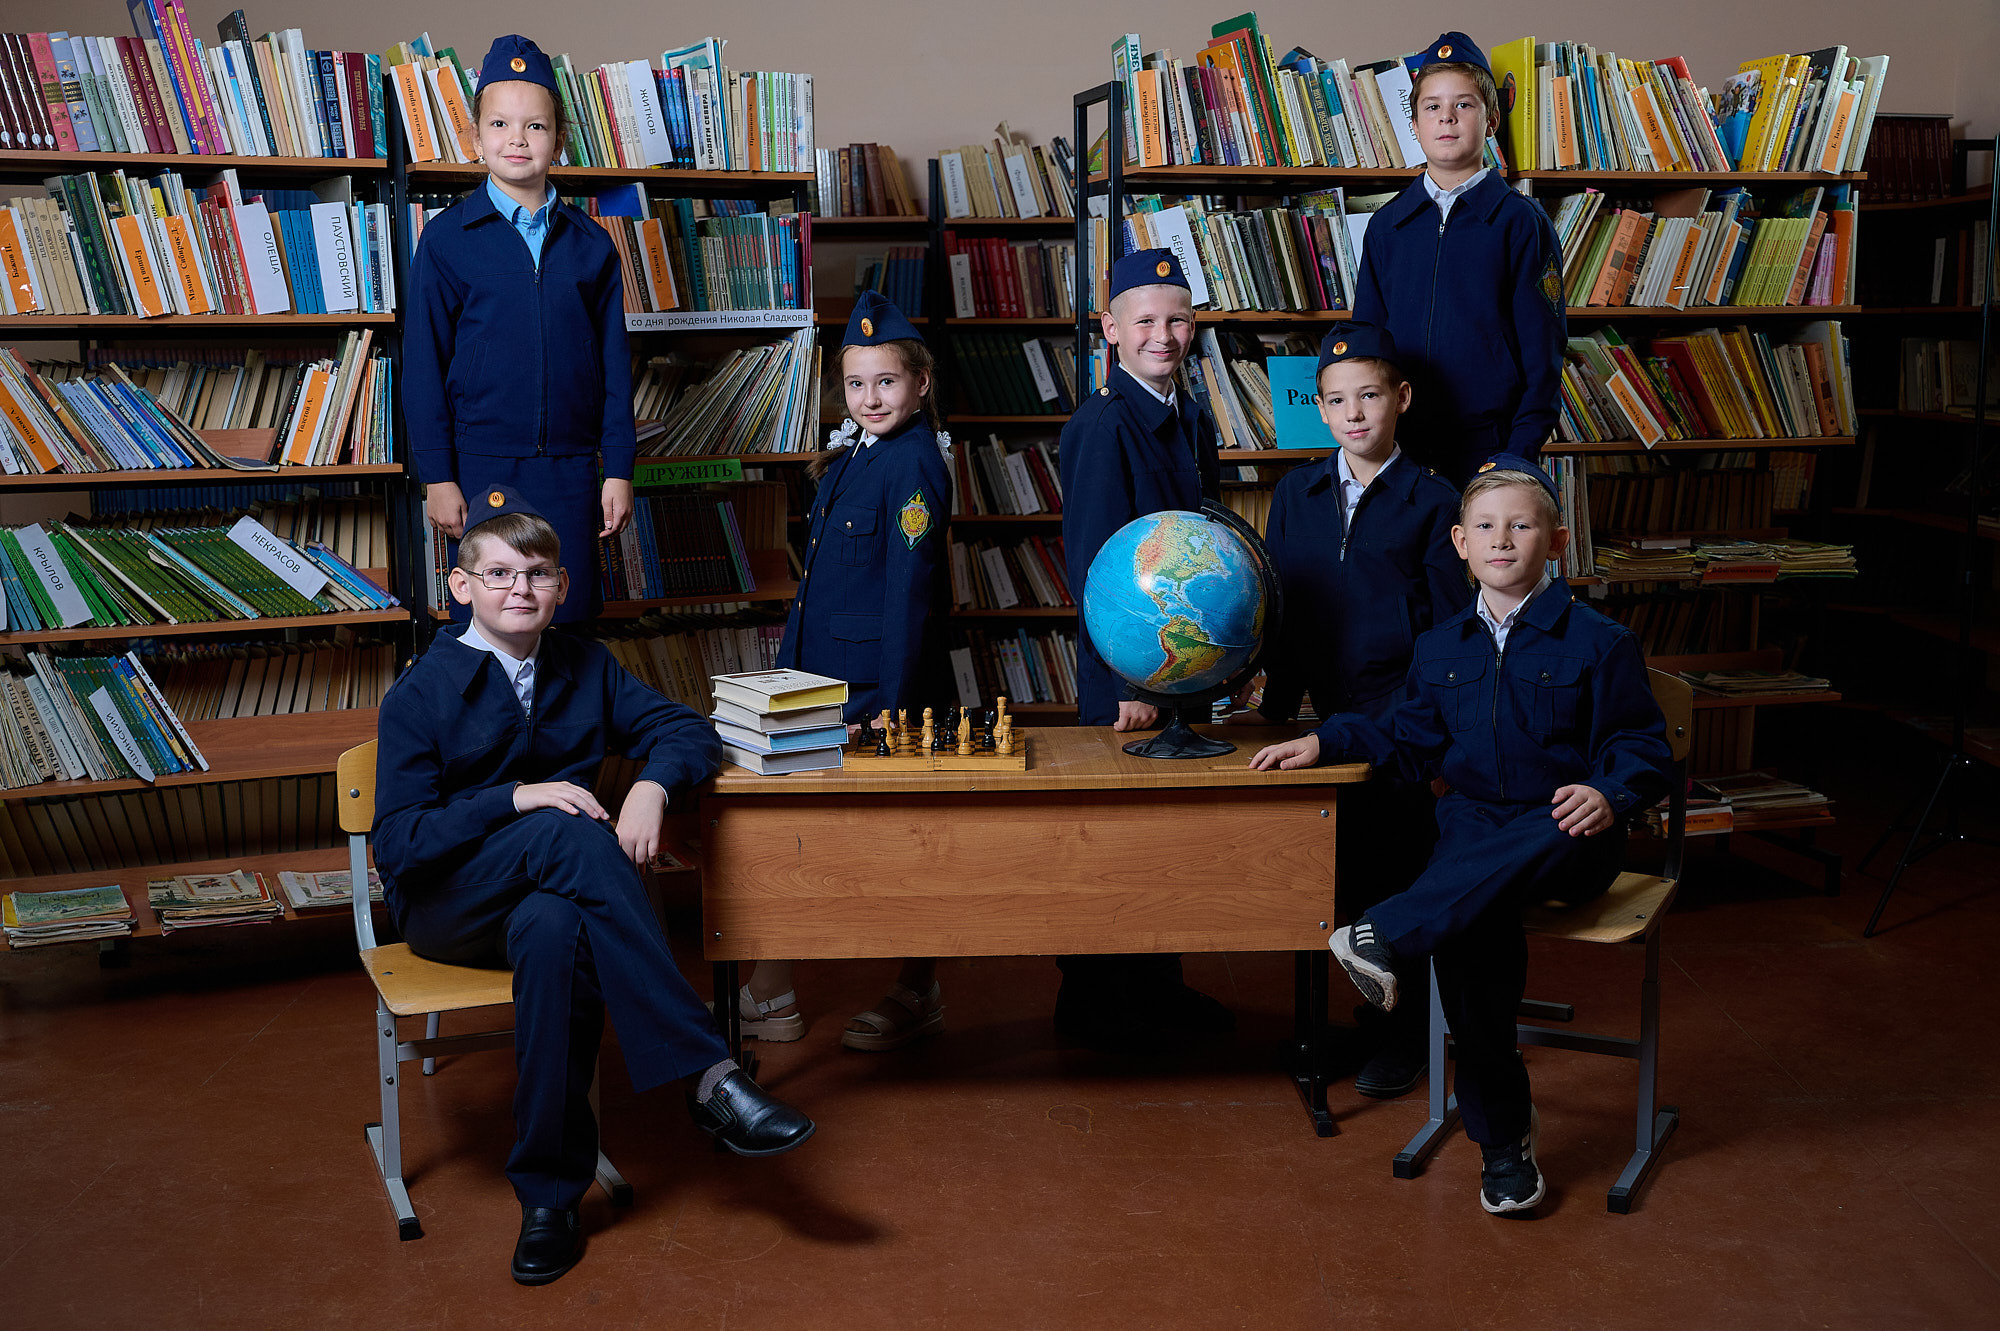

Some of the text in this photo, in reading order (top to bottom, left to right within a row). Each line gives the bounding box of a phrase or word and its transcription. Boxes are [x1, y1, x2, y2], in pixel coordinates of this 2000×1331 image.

[182, 21, 196, 58] РОССИИ
[107, 62, 116, 82] РОССИИ
[116, 63, 125, 82] РОССИИ
[160, 15, 199, 132] СКАЗКИ НАРОДОВ РОССИИ
[1129, 43, 1140, 72] АЗКИ
[131, 82, 139, 91] ЗА
[146, 82, 154, 92] ЗА
[163, 90, 171, 99] ЗА
[193, 60, 209, 102] НАРОДОВ
[404, 76, 416, 106] природе
[142, 117, 149, 126] ЗА
[156, 117, 164, 126] ЗА
[205, 104, 219, 138] СКАЗКИ
[447, 97, 463, 134] Бианки В.
[640, 88, 656, 135] ЖИТКОВ
[700, 93, 716, 164] БРОДЯГИ СЕВЕРА
[1140, 90, 1152, 159] Сказки зарубежных
[1149, 99, 1159, 134] писателей
[1312, 87, 1335, 155] СКАЗКИ СТАРОЙ АНГЛИИ
[1645, 110, 1657, 132] Барто
[1833, 113, 1846, 139] Заходер
[173, 126, 181, 134] ЗА
[412, 113, 424, 147] Рассказы
[1559, 115, 1567, 148] Сборники
[946, 158, 961, 203] Математика
[1013, 169, 1024, 196] Физика
[3, 242, 12, 252] П.
[173, 235, 188, 270] Сибиряк
[264, 231, 280, 276] ОЛЕША
[329, 215, 354, 299] ПАУСТОВСКИЙ
[378, 235, 386, 262] СКАЗКИ
[650, 244, 662, 283] Сладков Н.
[1170, 233, 1191, 278] БЁРНЕТТ
[1675, 239, 1694, 283] Маяковский
[134, 249, 151, 285] Ершов П.
[184, 273, 196, 300] Мамин
[631, 312, 808, 328] со дня рождения Николая Сладкова
[1000, 302, 1007, 312] 2
[1010, 302, 1017, 312] 3
[99, 381, 135, 424] АЛЕКСАНДР ПУШКИН
[297, 405, 310, 433] Толстой
[1615, 390, 1647, 430] К. Чуковский
[7, 405, 37, 445] Пушкин А.
[643, 462, 733, 484] ДРУЖИТЬ
[34, 546, 64, 592] КРЫЛОВ
[251, 531, 301, 574] НЕКРАСОВ
[295, 543, 334, 576] АЛЕКСАНДР ПУШКИН
[117, 672, 149, 720] Четыре желания
[2, 680, 44, 758] ТОЛСТОЙ ДЛЯ ДЕТЕЙ
[18, 688, 60, 763] ТОЛСТОЙ ДЛЯ ДЕТЕЙ
[104, 711, 144, 772] УШИНСКИЙ
